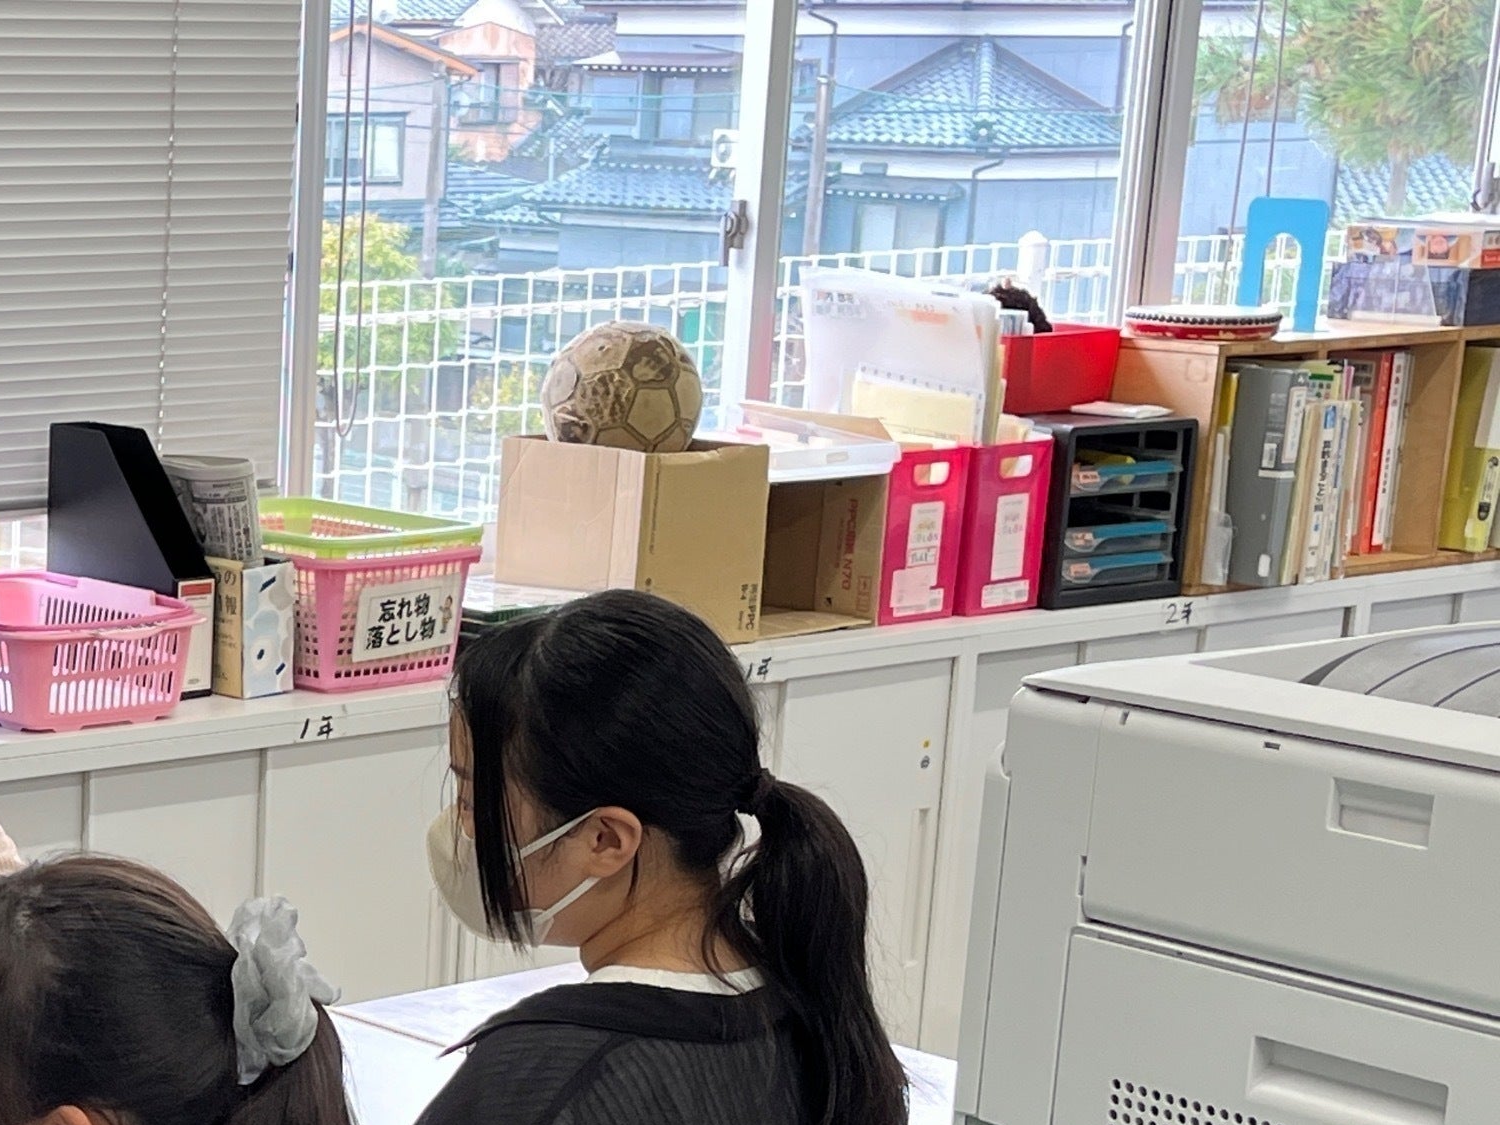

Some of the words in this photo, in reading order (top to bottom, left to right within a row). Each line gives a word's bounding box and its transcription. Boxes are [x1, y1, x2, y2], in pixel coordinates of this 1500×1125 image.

[378, 593, 431, 622] 忘れ物
[365, 616, 436, 650] 落とし物
[300, 715, 334, 740] 1年
